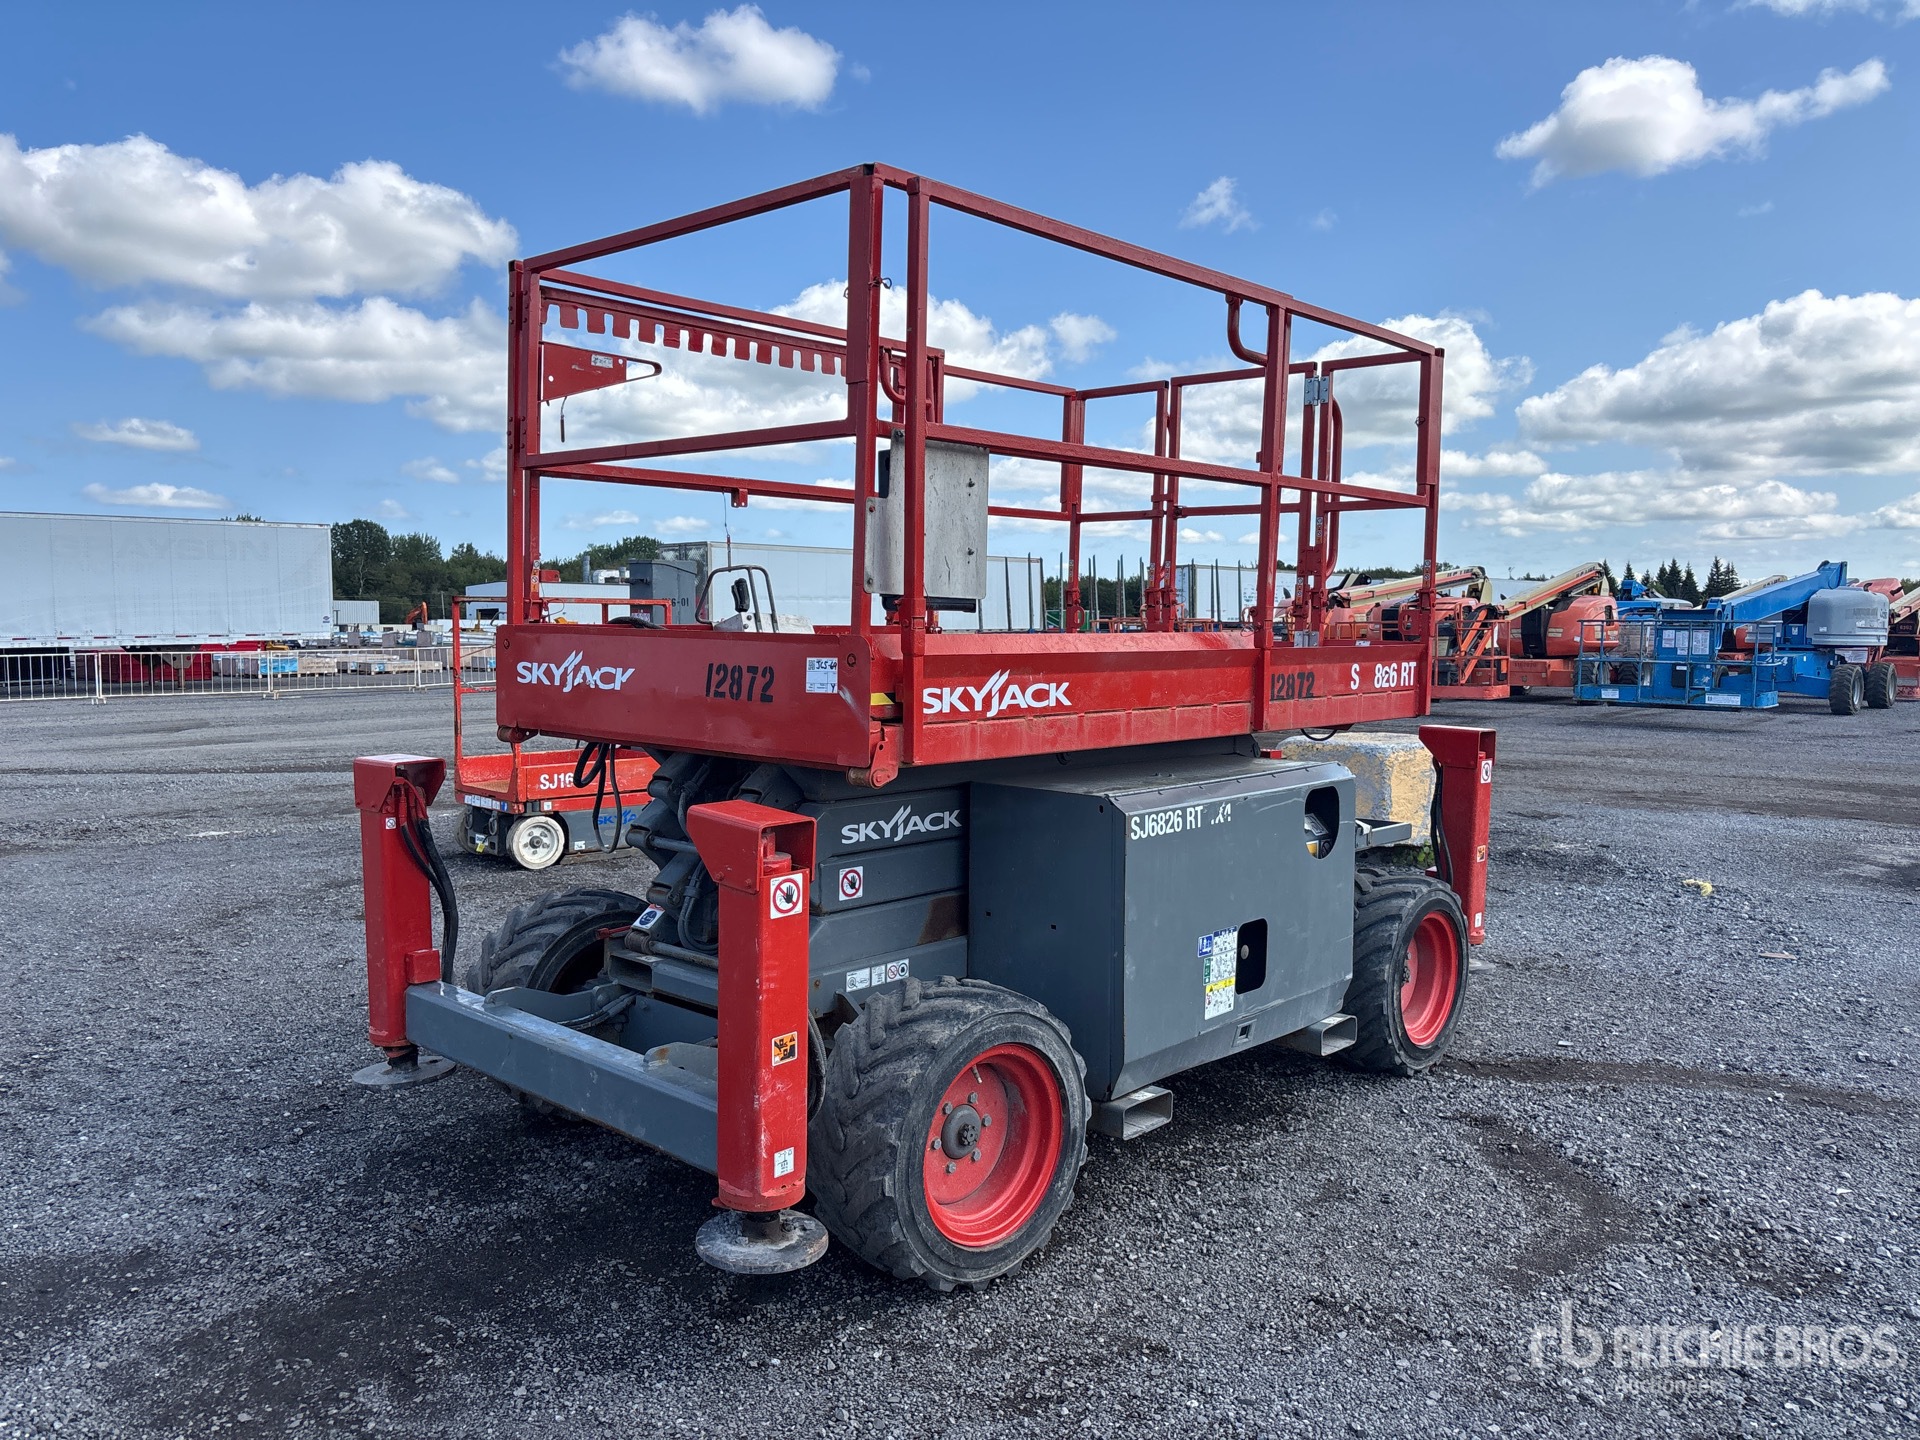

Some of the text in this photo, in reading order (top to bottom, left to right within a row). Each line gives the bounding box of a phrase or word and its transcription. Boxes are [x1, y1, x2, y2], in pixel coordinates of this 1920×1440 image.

[516, 650, 635, 693] SKYJACK
[705, 663, 775, 703] 12872
[1270, 671, 1315, 702] 12872
[1400, 661, 1417, 687] RT
[922, 669, 1073, 718] SKYJACK
[540, 772, 575, 790] SJ16
[841, 804, 963, 845] SKYJACK
[1130, 809, 1183, 841] SJ6826
[1186, 805, 1204, 830] RT
